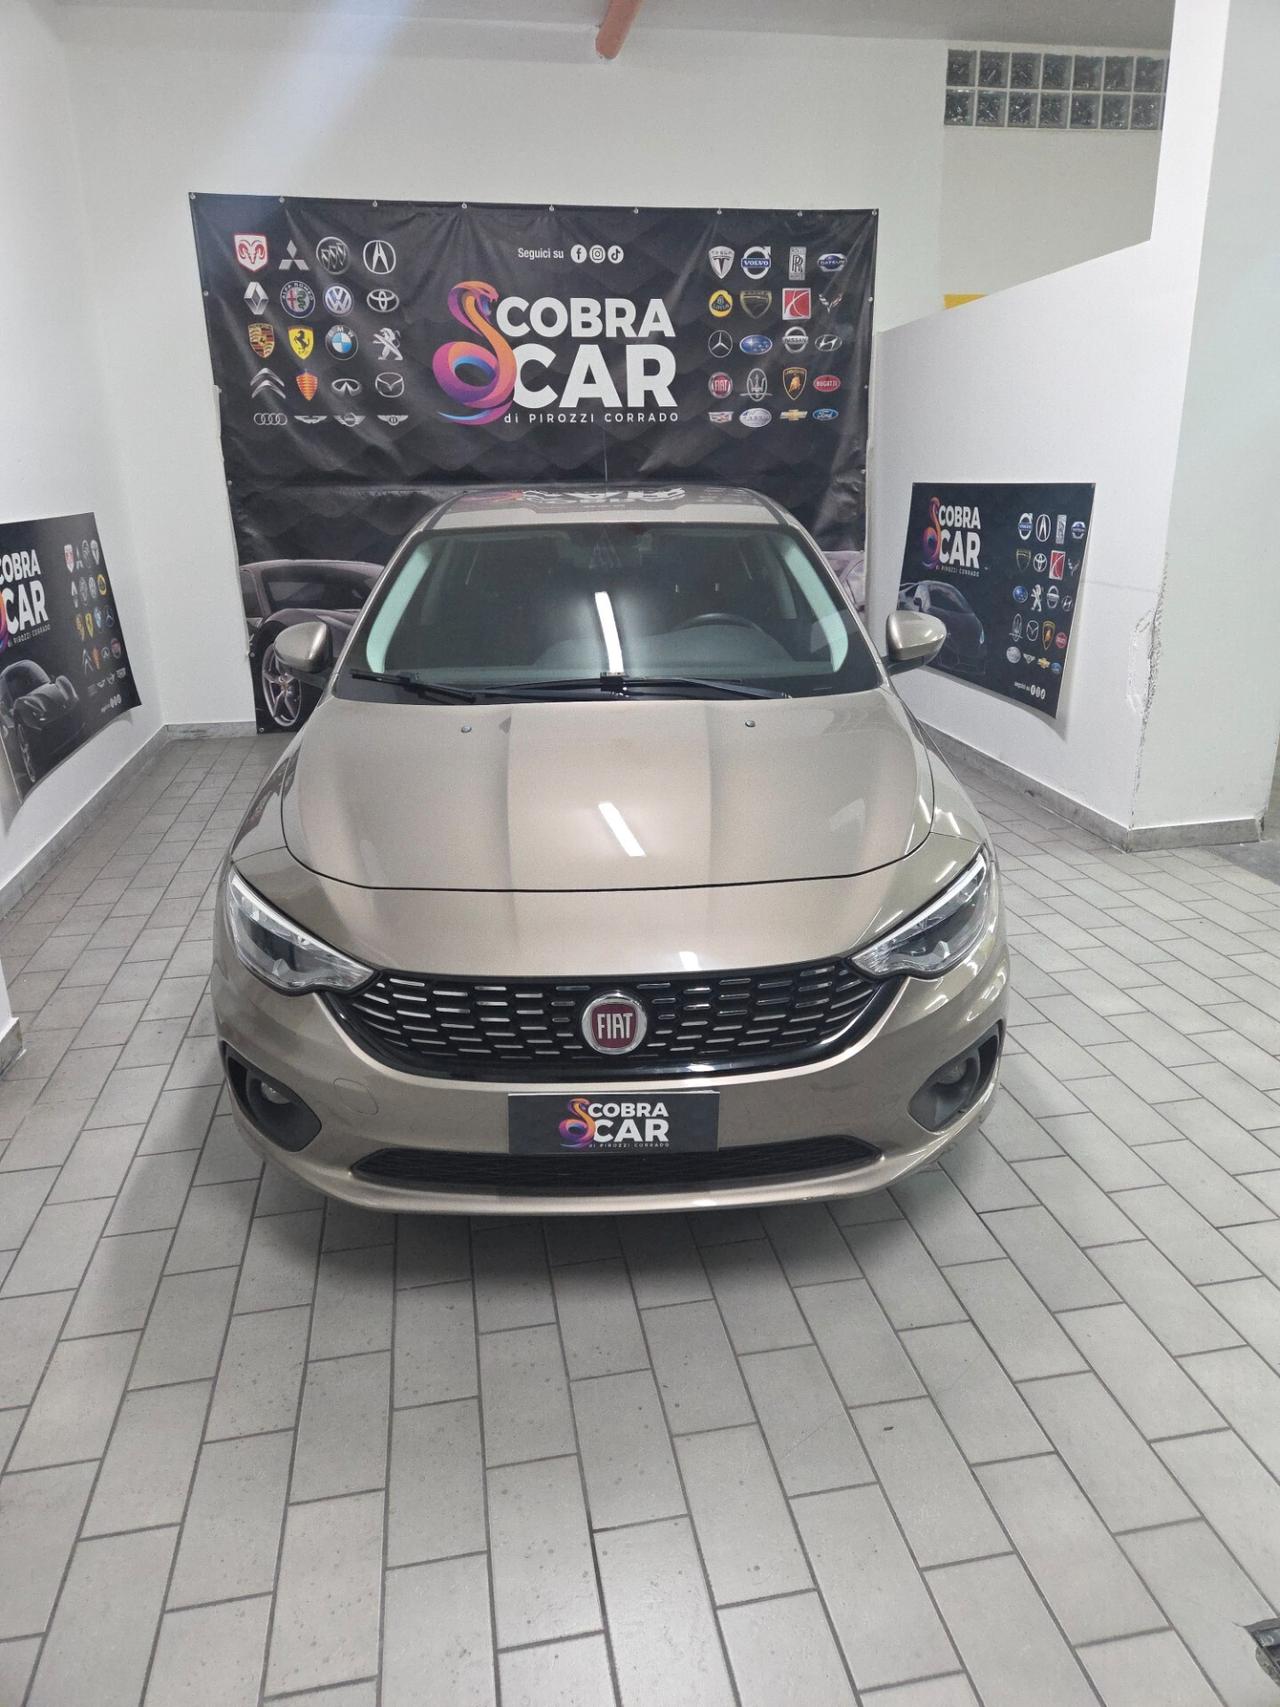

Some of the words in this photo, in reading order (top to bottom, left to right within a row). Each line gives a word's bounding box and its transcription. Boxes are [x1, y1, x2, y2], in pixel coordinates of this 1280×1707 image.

[517, 247, 551, 260] Seguici
[553, 249, 564, 259] su
[496, 296, 676, 338] COBRA
[512, 343, 678, 409] CAR
[714, 380, 729, 392] FIAT
[504, 413, 519, 423] di
[529, 413, 595, 423] PIROZZI
[604, 412, 679, 422] CORRADO
[938, 505, 981, 530] COBRA
[939, 529, 981, 569] CAR
[2, 580, 49, 635] CAR
[597, 1012, 633, 1040] FIAT
[587, 1102, 669, 1118] COBRA
[593, 1119, 669, 1143] CAR
